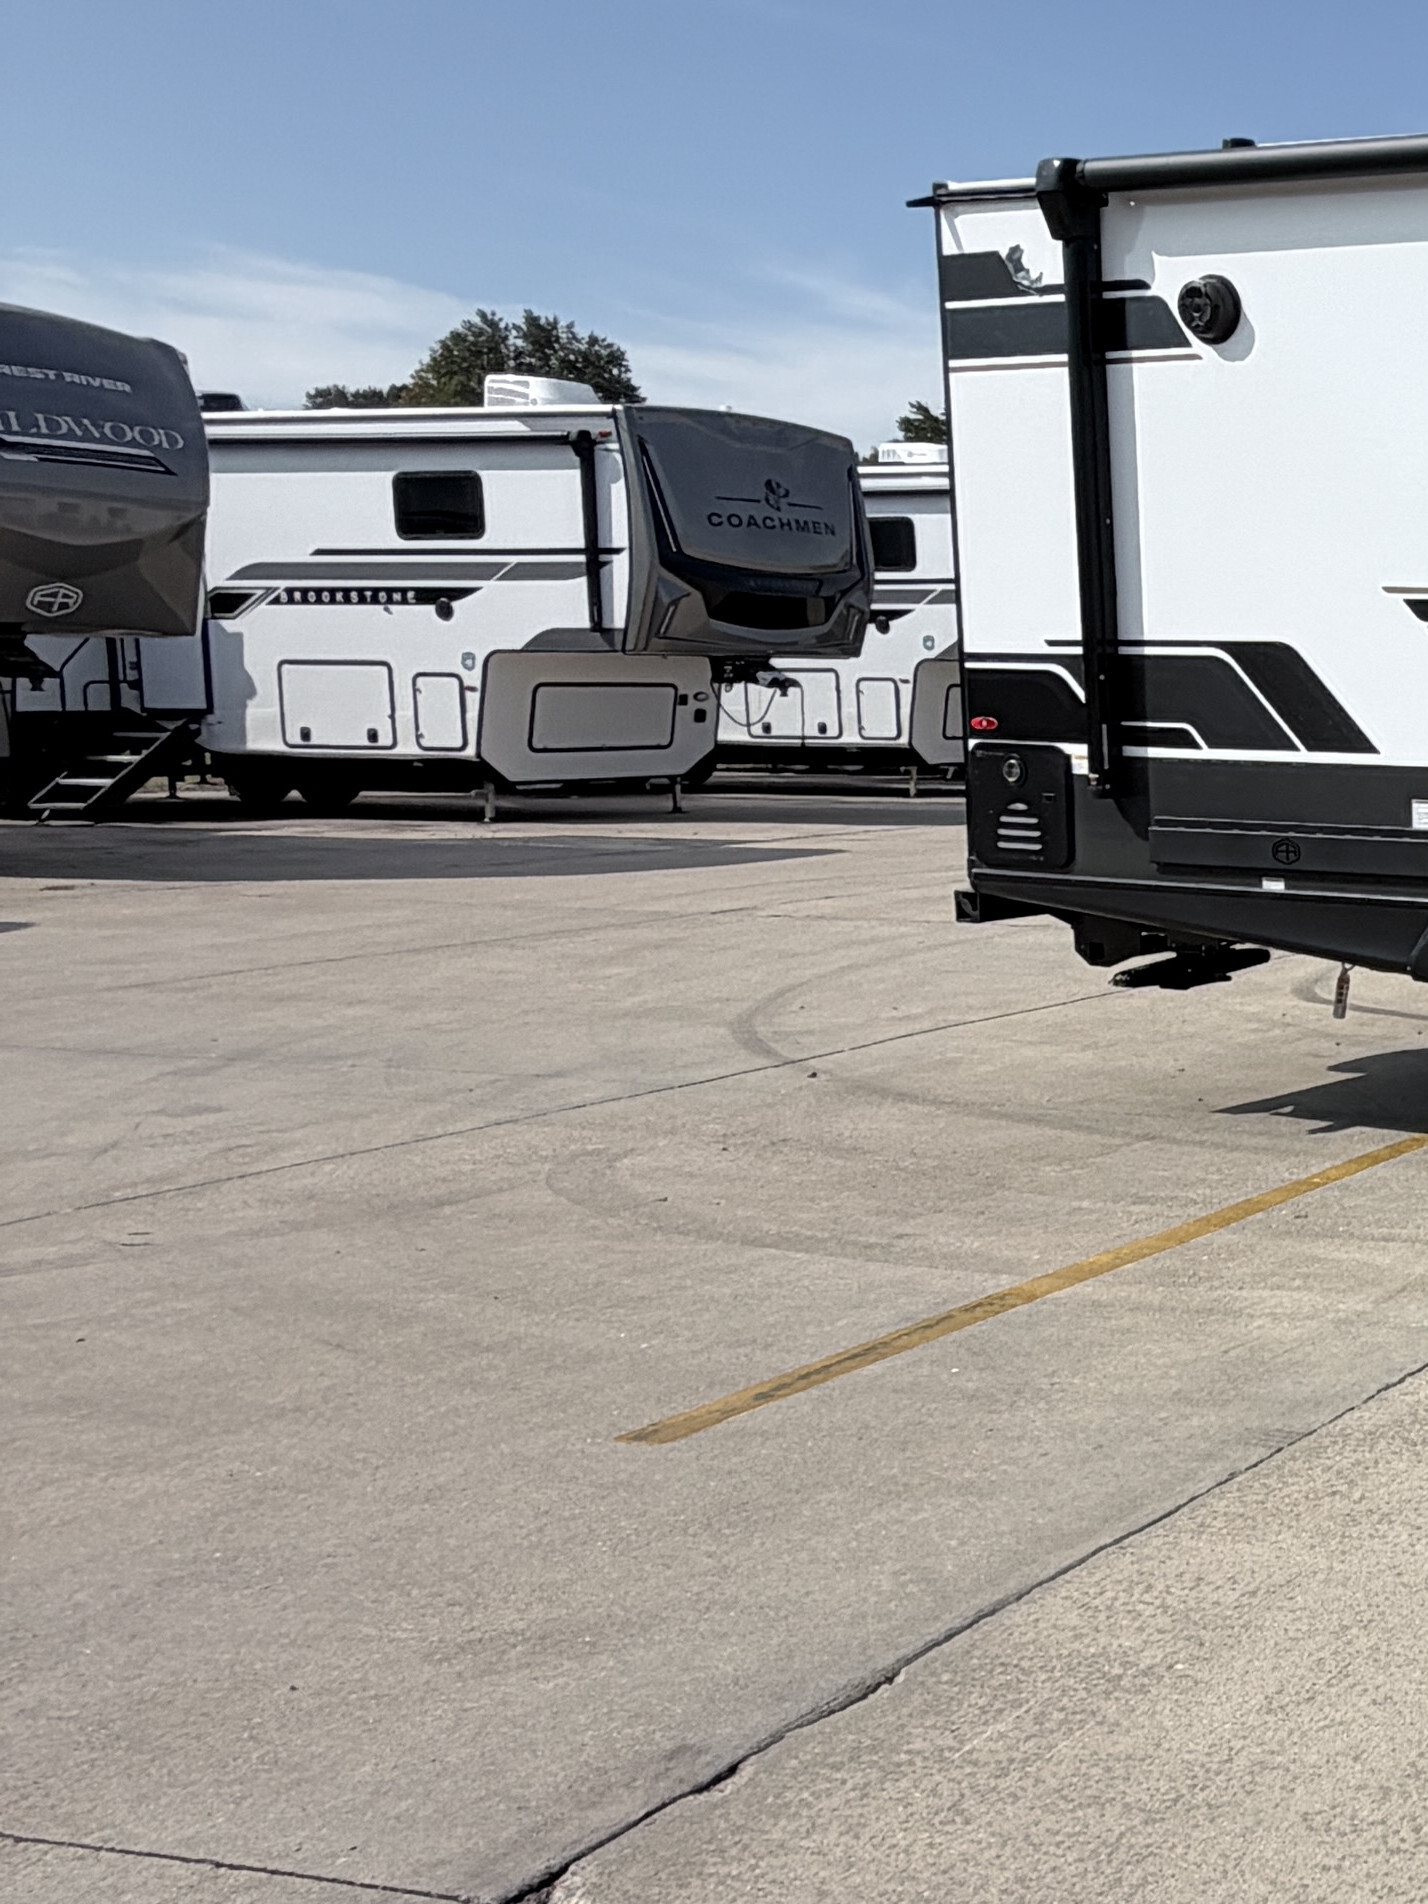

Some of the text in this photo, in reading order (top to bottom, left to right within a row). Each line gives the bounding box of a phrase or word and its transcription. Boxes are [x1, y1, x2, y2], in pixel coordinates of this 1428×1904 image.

[61, 371, 133, 393] RIVER
[707, 512, 836, 536] COACHMEN
[280, 590, 416, 603] BROOKSTONE
